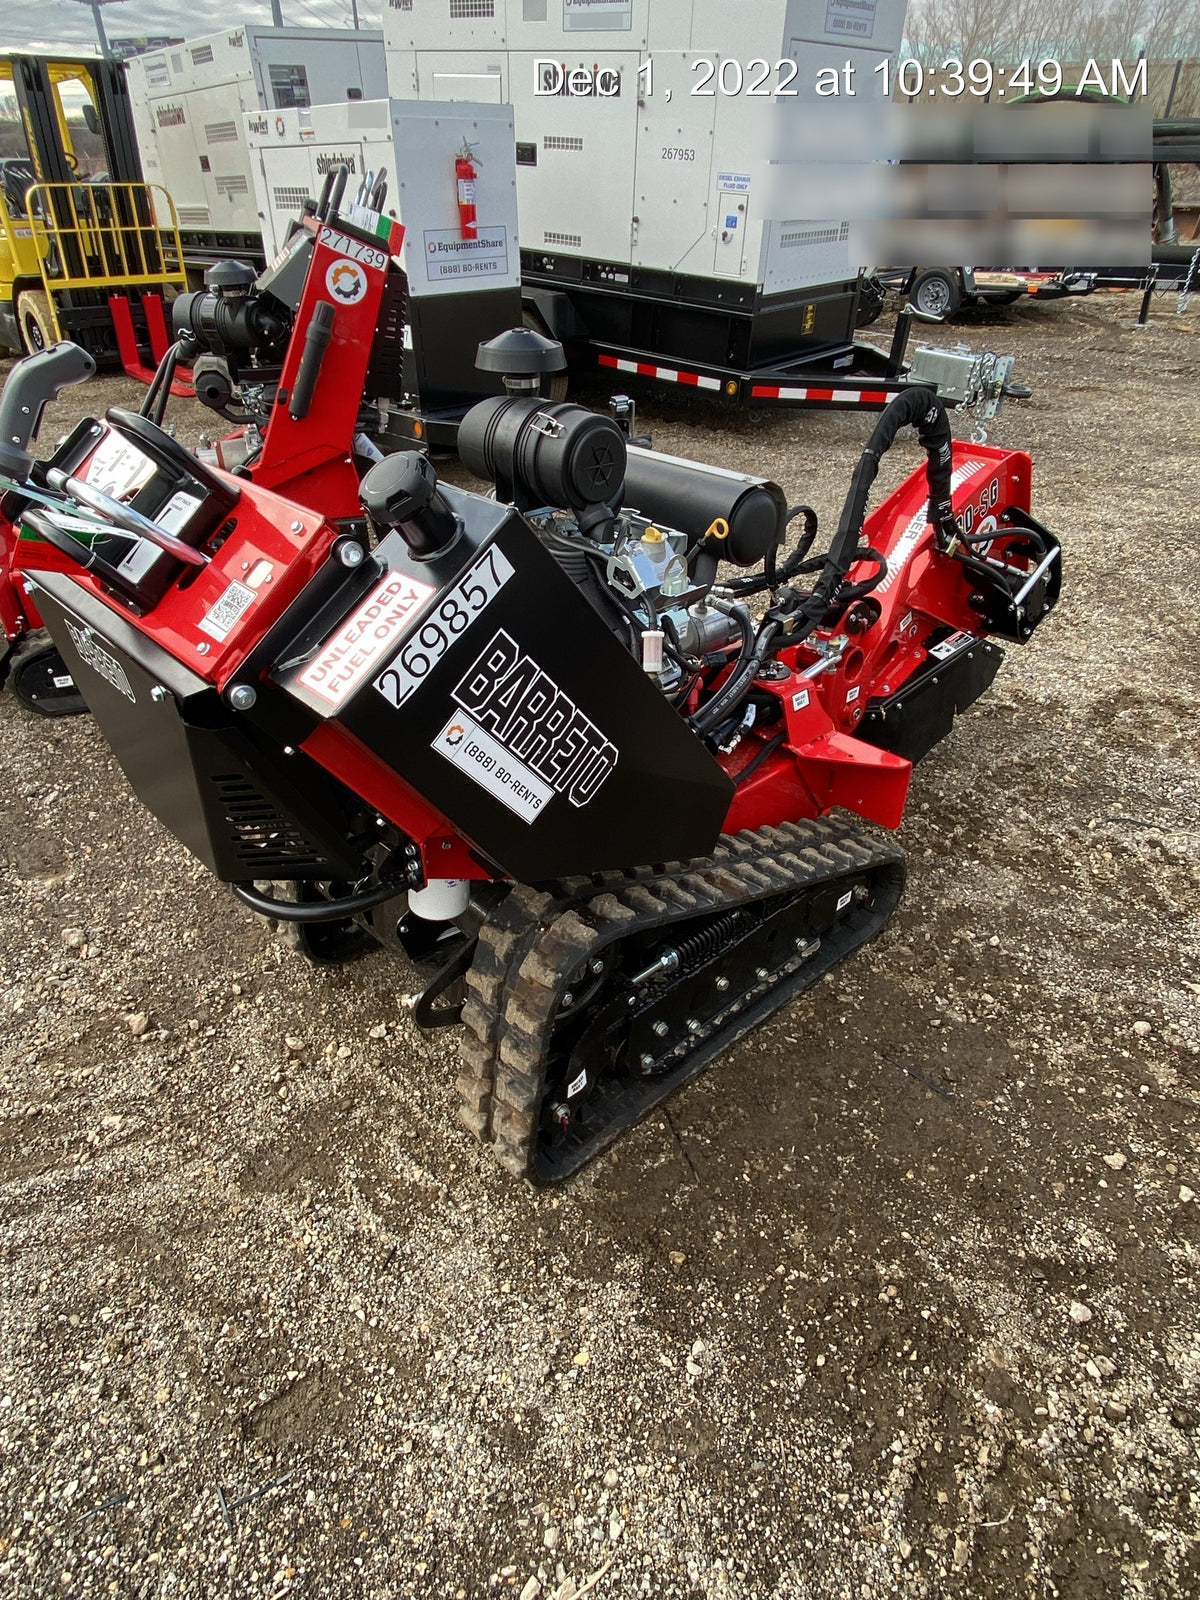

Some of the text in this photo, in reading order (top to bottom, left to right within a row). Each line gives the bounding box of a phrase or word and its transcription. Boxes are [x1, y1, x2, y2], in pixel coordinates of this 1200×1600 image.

[661, 147, 696, 161] 267953
[320, 228, 386, 270] 271739
[438, 240, 504, 253] EquipmentShare
[440, 261, 498, 275] (888) 80-RENTS
[310, 581, 402, 682] UNLEADED
[327, 588, 419, 693] FUEL ONLY
[379, 549, 502, 706] 269857
[450, 627, 619, 808] BARRETO
[463, 740, 543, 810] (888) 80-RENTS
